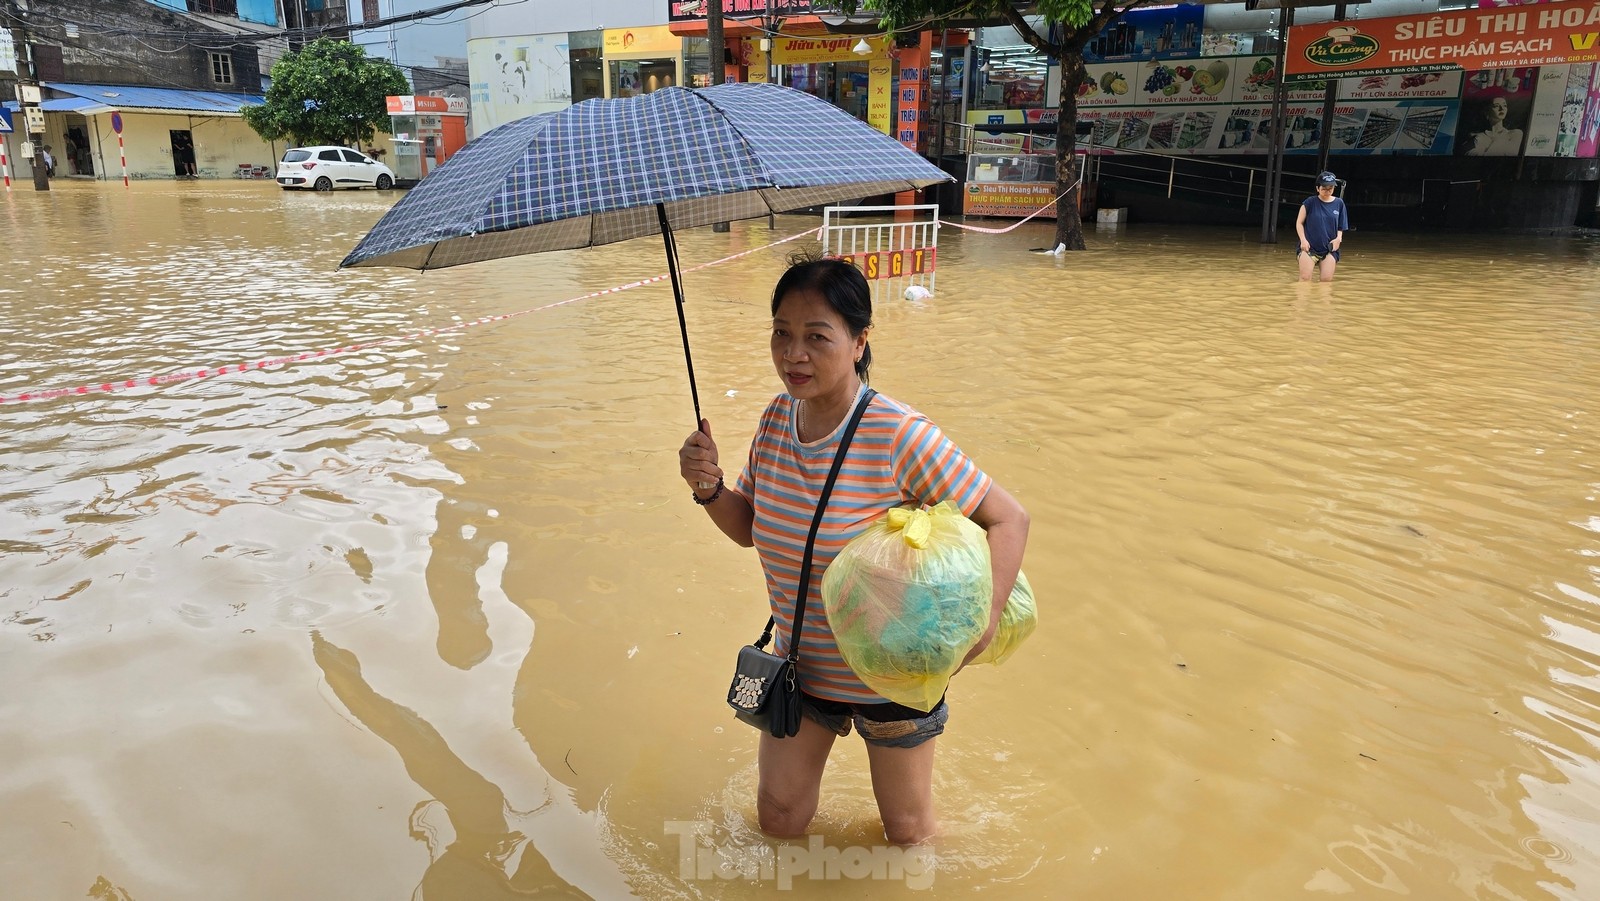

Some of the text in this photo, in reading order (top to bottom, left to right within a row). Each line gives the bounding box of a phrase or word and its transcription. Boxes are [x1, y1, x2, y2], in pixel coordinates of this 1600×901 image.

[1395, 16, 1466, 40] SIÊU
[1477, 12, 1527, 34] THỊ
[785, 40, 815, 51] Hữu
[1388, 38, 1552, 63] THỰC PHẨM SẠCH
[1568, 32, 1600, 51] V
[1482, 60, 1498, 68] SẢN
[1499, 59, 1517, 67] XUẤT
